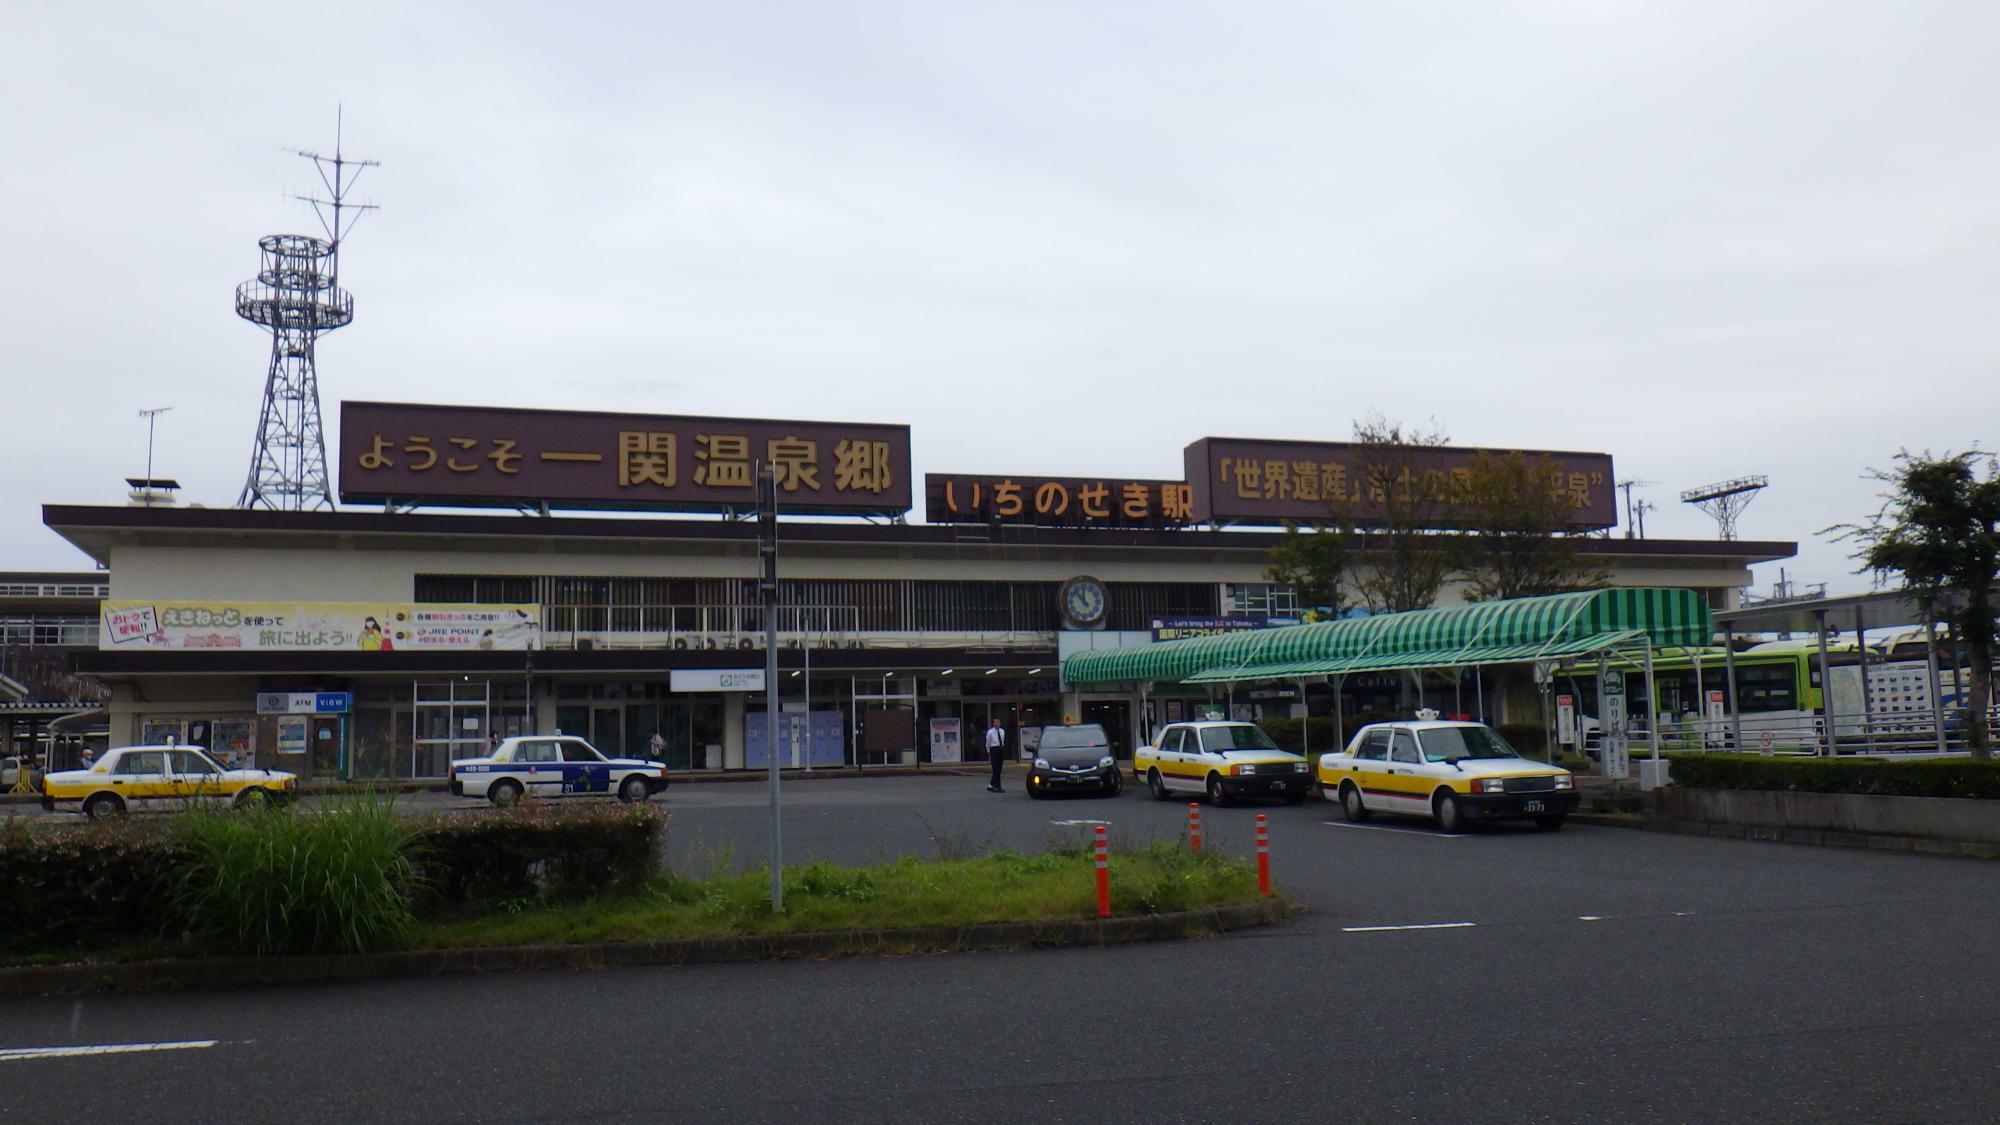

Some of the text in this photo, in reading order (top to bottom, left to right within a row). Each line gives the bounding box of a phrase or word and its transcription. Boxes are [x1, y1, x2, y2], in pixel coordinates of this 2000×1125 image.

[945, 479, 1194, 519] いちのせき駅
